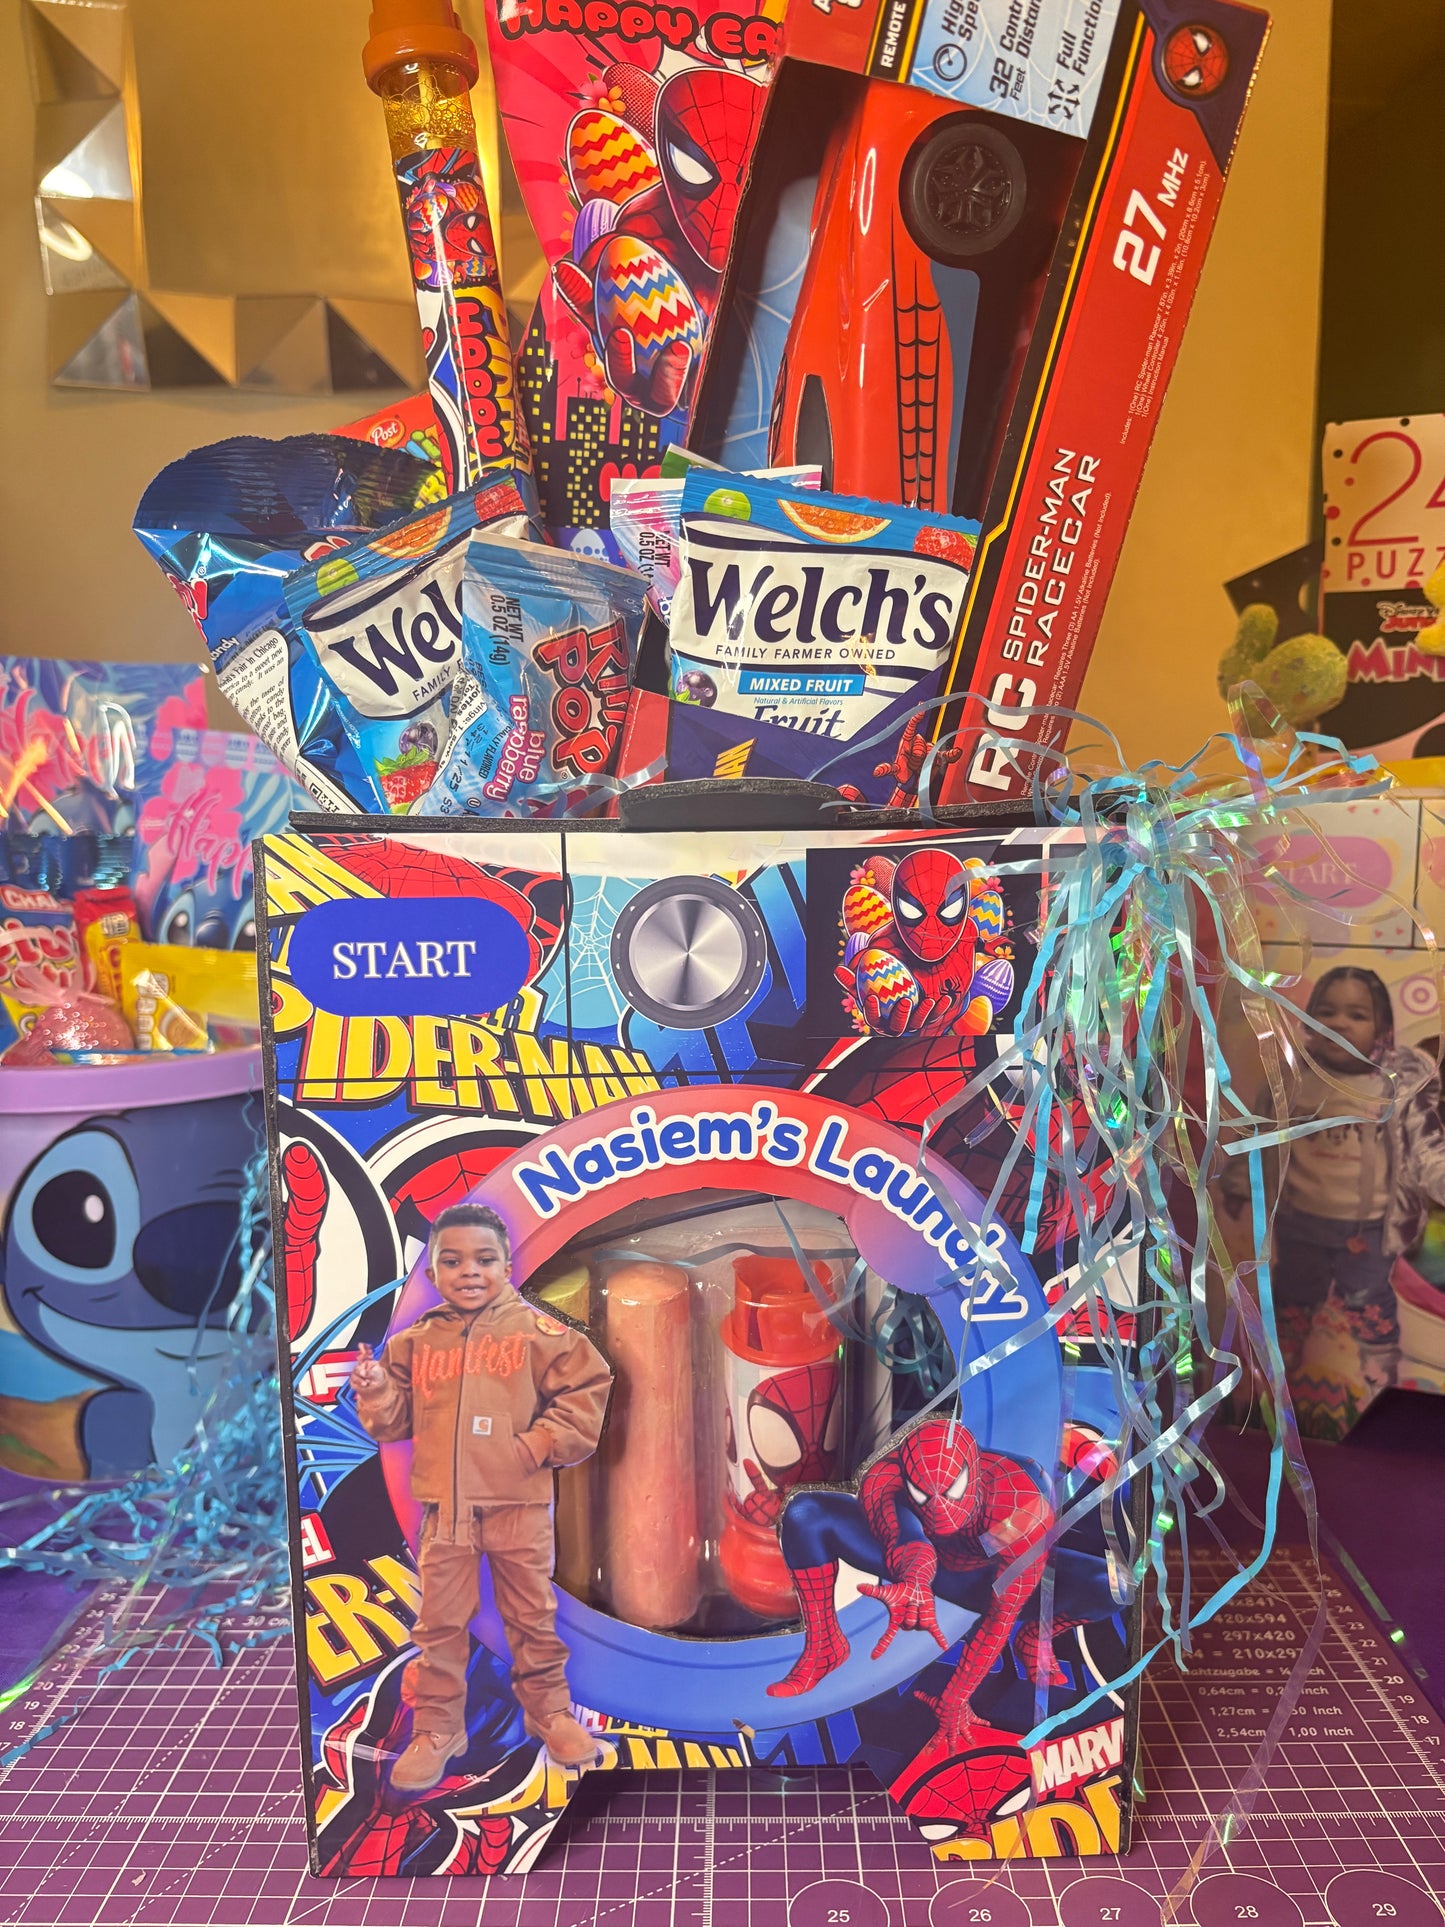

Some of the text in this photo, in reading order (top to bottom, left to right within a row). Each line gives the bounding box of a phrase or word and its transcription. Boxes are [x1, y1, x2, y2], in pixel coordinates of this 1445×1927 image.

[501, 0, 697, 48] HAPPY
[880, 1, 907, 68] REMOTE
[1056, 30, 1077, 70] Full
[989, 57, 1014, 99] 32
[1010, 67, 1026, 101] Feet
[1112, 146, 1190, 287] 27 MHz
[1134, 380, 1142, 391] RC
[1148, 312, 1162, 340] Racecar
[1140, 371, 1152, 393] Wheel
[1147, 338, 1162, 371] Controller
[1147, 361, 1162, 395] Instruction
[1156, 335, 1169, 360] Manual
[448, 302, 503, 458] HAPPY
[371, 422, 398, 446] Post
[1093, 522, 1103, 538] (Not
[638, 531, 656, 562] 0.5 OZ
[1003, 448, 1077, 662] SPIDER-MAN
[1084, 538, 1098, 567] Batteries
[653, 552, 671, 568] WT
[1026, 454, 1101, 668] RACECAR
[1077, 567, 1090, 594] Alkaline
[489, 593, 507, 614] 0.5
[687, 557, 954, 651] Welch's
[1070, 610, 1078, 620] AA
[491, 614, 508, 635] OZ
[503, 595, 525, 644] NET WT
[1067, 620, 1076, 631] (3)
[328, 579, 462, 697] Wel
[1057, 675, 1066, 690] AAA
[1065, 633, 1079, 659] Alkaline
[1073, 604, 1087, 633] Batteries
[1082, 588, 1092, 604] (Not
[1061, 631, 1072, 650] Three
[232, 662, 247, 680] Fair
[254, 637, 279, 659] Chicago
[241, 674, 248, 682] to
[254, 657, 271, 675] sweet
[271, 647, 283, 662] new
[715, 644, 896, 660] FAMILY FARMER OWNED
[1052, 650, 1067, 680] Requires
[412, 665, 451, 702] FAMILY
[750, 677, 853, 693] MIXED FRUIT
[536, 626, 611, 776] POP
[753, 696, 780, 705] Natural
[789, 697, 818, 706] Artificial
[820, 697, 844, 706] Flavors
[969, 673, 1037, 791] RC
[476, 744, 498, 779] FLAVORED
[519, 731, 545, 782] blue
[1020, 770, 1032, 795] Remte
[331, 940, 476, 981] START
[515, 1103, 805, 1215] Nasiem's
[1222, 1630, 1296, 1642] 297x420
[1360, 1638, 1377, 1648] 22
[1371, 1657, 1388, 1666] 21
[34, 1681, 53, 1691] 20
[1198, 1686, 1246, 1697] 0,64cm
[1383, 1675, 1405, 1685] 20
[23, 1700, 39, 1711] 19
[1209, 1706, 1343, 1717] 1,27cm Inch
[1397, 1694, 1415, 1704] 19
[8, 1720, 25, 1731] 18
[1216, 1726, 1354, 1738] 2,54cm 1,00 Inch
[1411, 1714, 1430, 1725] 18
[1423, 1735, 1441, 1746] 17
[827, 1907, 850, 1923] 25
[968, 1907, 992, 1923] 26
[1100, 1906, 1122, 1921] 27
[1234, 1905, 1259, 1920] 28
[1372, 1902, 1397, 1917] 29
